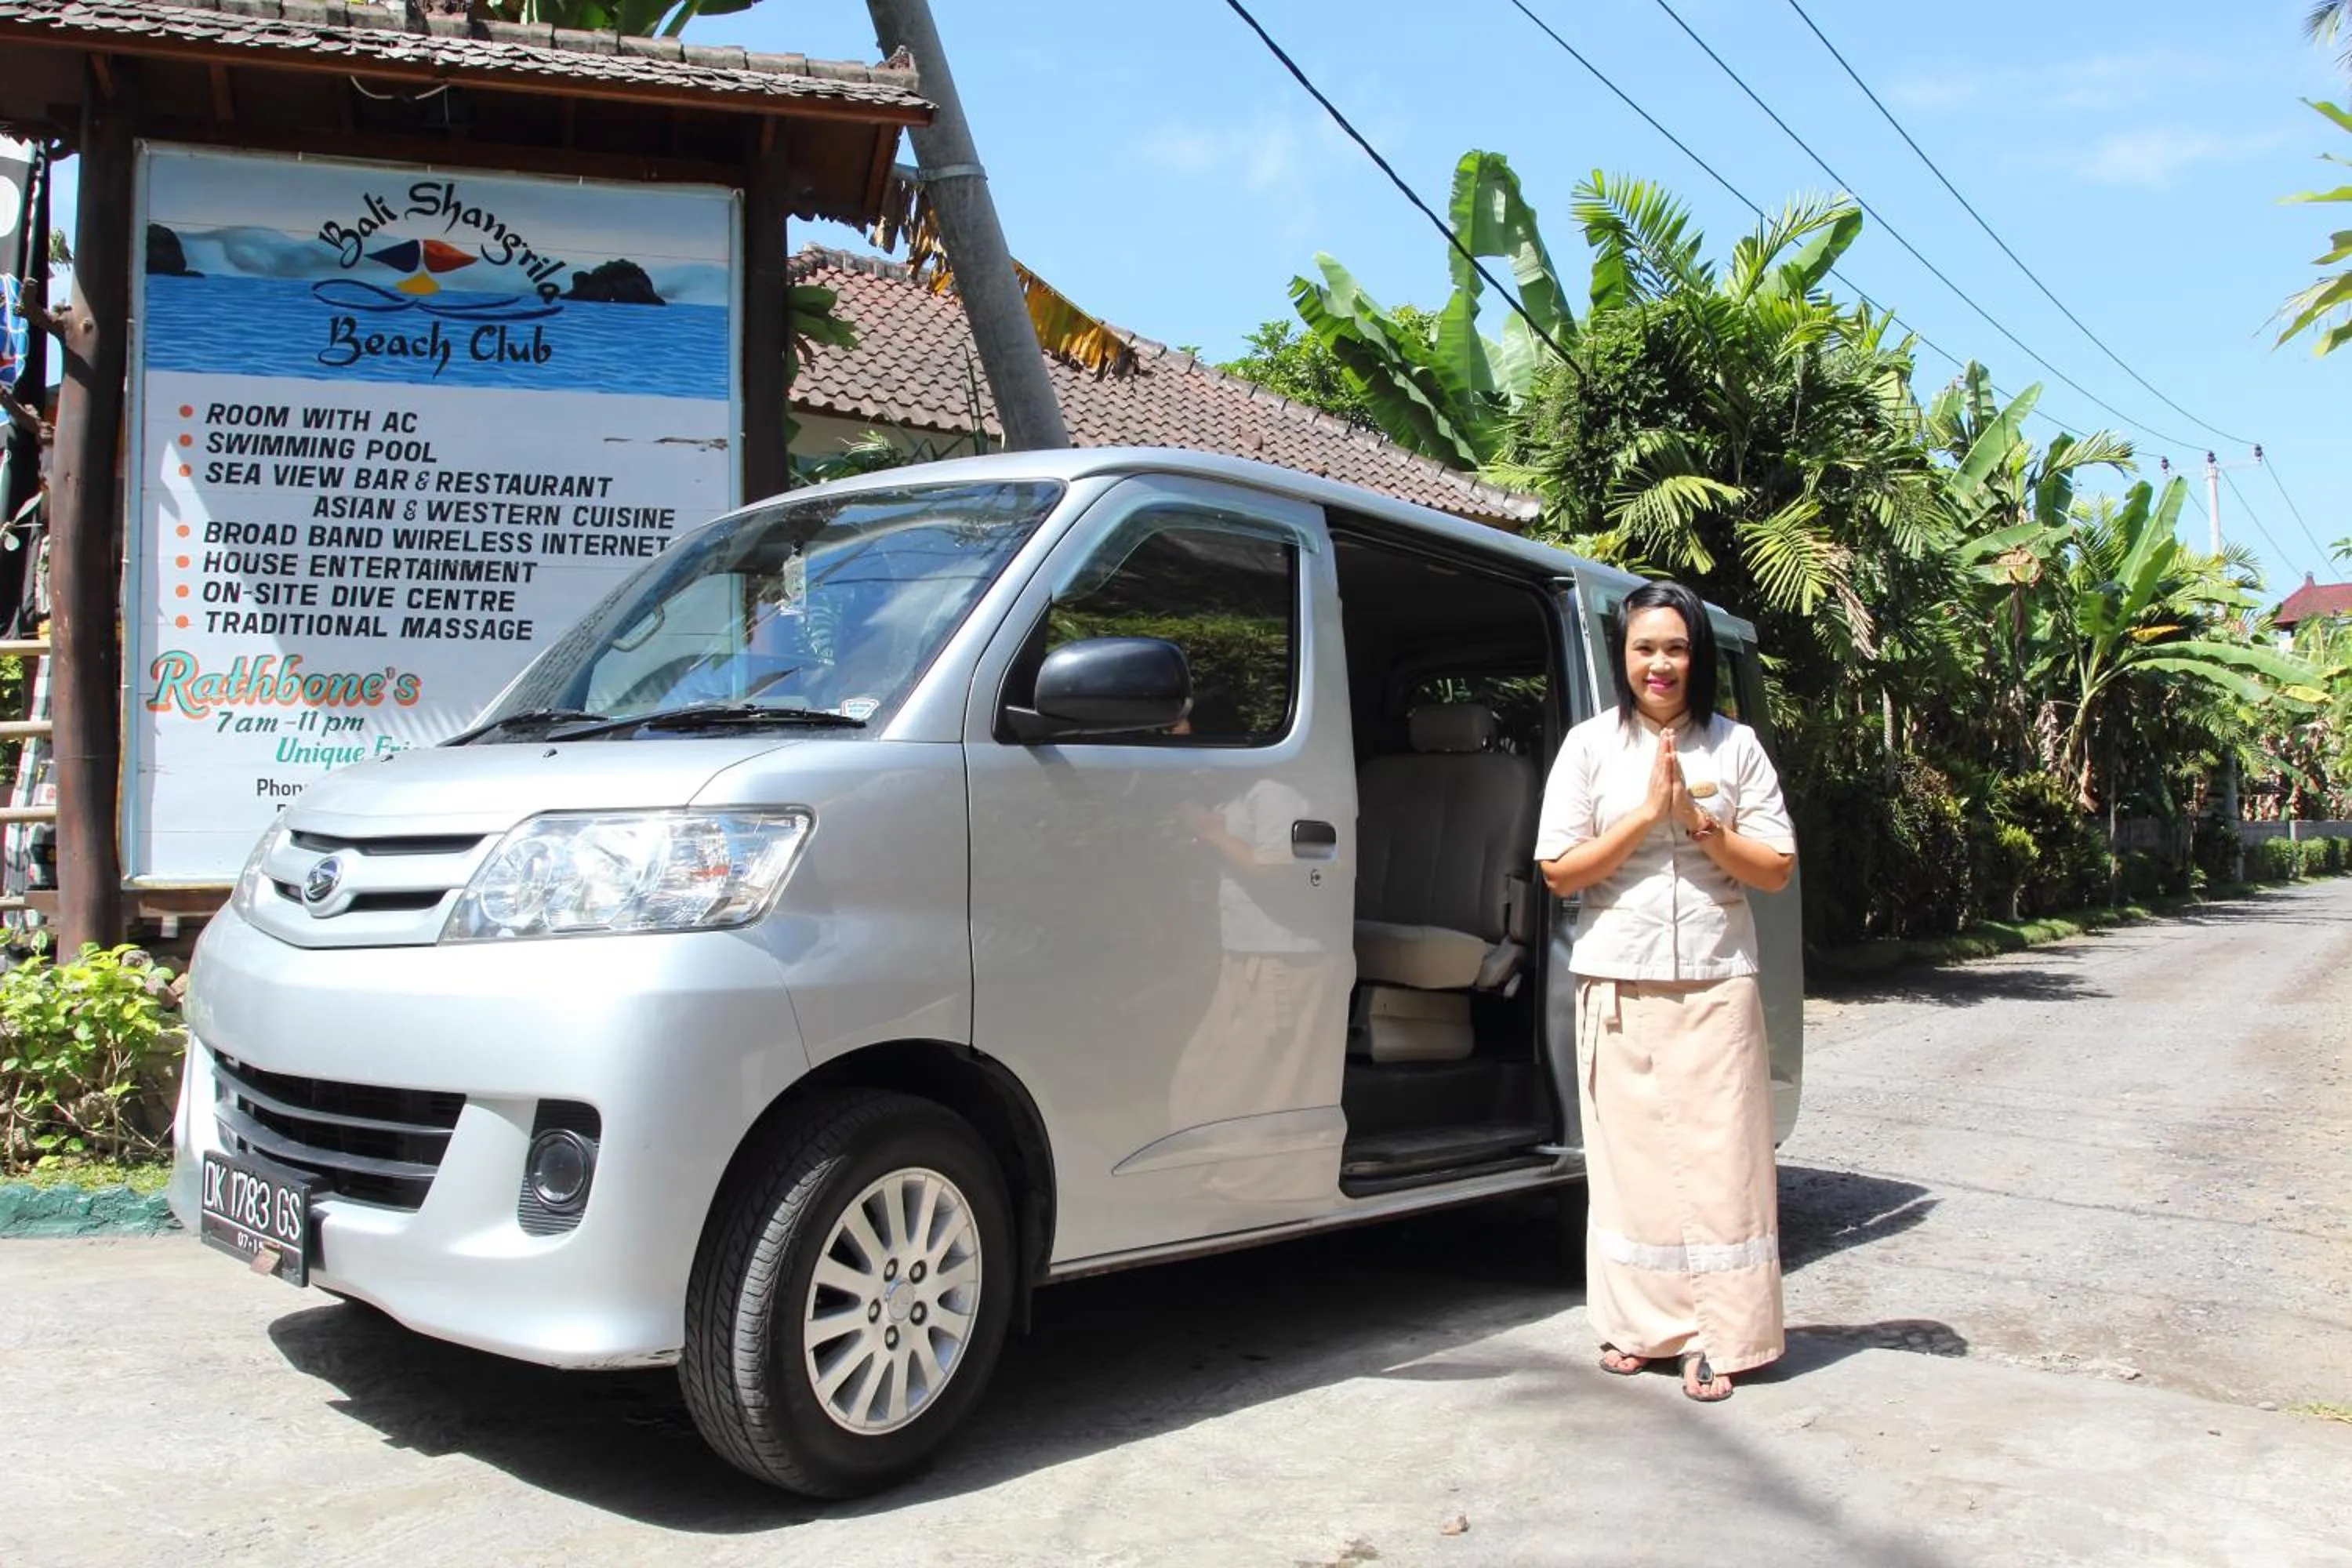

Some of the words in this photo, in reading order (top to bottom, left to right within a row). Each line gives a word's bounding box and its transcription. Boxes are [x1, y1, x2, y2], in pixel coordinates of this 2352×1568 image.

[318, 192, 398, 269] Bali
[318, 315, 451, 380] Beach
[470, 325, 552, 365] Club
[205, 403, 290, 428] ROOM
[303, 407, 371, 431] WITH
[382, 412, 418, 434] AC
[205, 431, 355, 459] SWIMMING
[365, 439, 437, 463] POOL
[205, 462, 261, 485] SEA
[274, 463, 344, 488] VIEW
[354, 468, 408, 491] BAR
[415, 471, 430, 491] &
[436, 470, 613, 499] RESTAURANT
[313, 495, 395, 521] ASIAN
[402, 499, 418, 521] &
[427, 499, 561, 527] WESTERN
[572, 505, 675, 530] CUISINE
[203, 521, 297, 546] BROAD
[307, 525, 383, 549] BAND
[393, 528, 533, 554] WIRELESS
[541, 533, 671, 557] INTERNET
[203, 551, 299, 576] HOUSE
[309, 554, 538, 583] ENTERTAINMENT
[202, 581, 318, 606] ON-SITE
[332, 585, 396, 608] DIVE
[407, 587, 516, 612] CENTRE
[205, 612, 388, 637] TRADITIONAL
[400, 616, 534, 641] MASSAGE
[146, 650, 423, 720] Rathbone's
[275, 736, 366, 771] Unique
[256, 778, 309, 797] Phon
[204, 1160, 227, 1211] DK
[231, 1171, 271, 1230] 1783
[277, 1187, 301, 1240] GS
